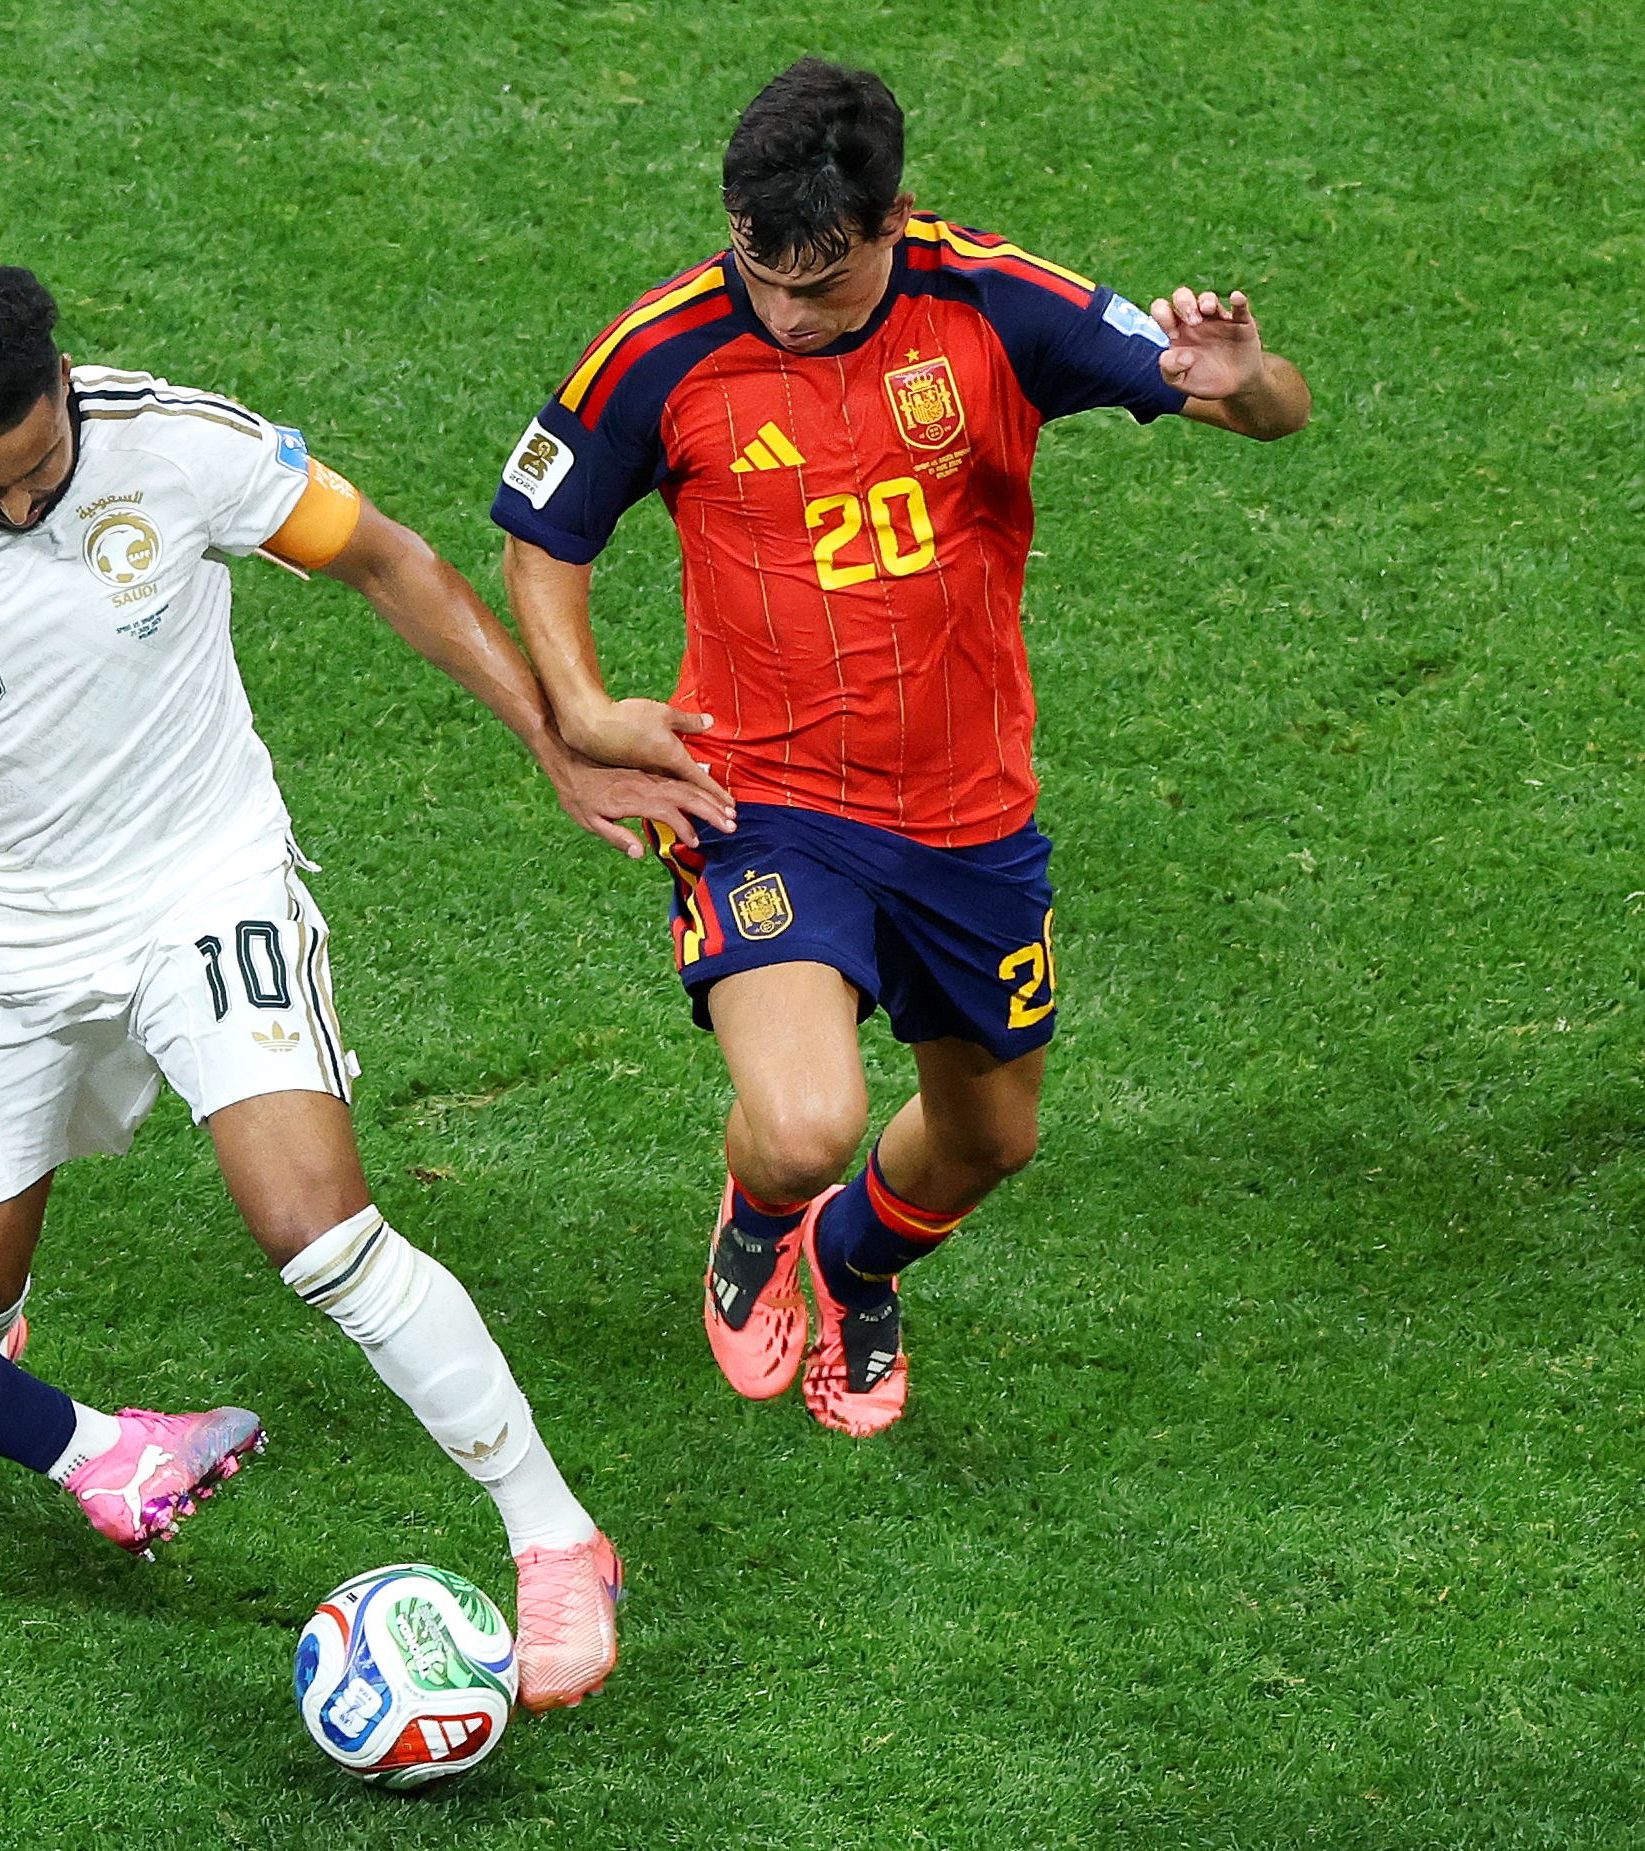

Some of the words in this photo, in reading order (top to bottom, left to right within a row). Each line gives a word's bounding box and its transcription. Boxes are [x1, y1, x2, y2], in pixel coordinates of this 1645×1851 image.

[806, 477, 935, 591] 20
[112, 583, 159, 608] SAUDI
[194, 920, 294, 1023] 10
